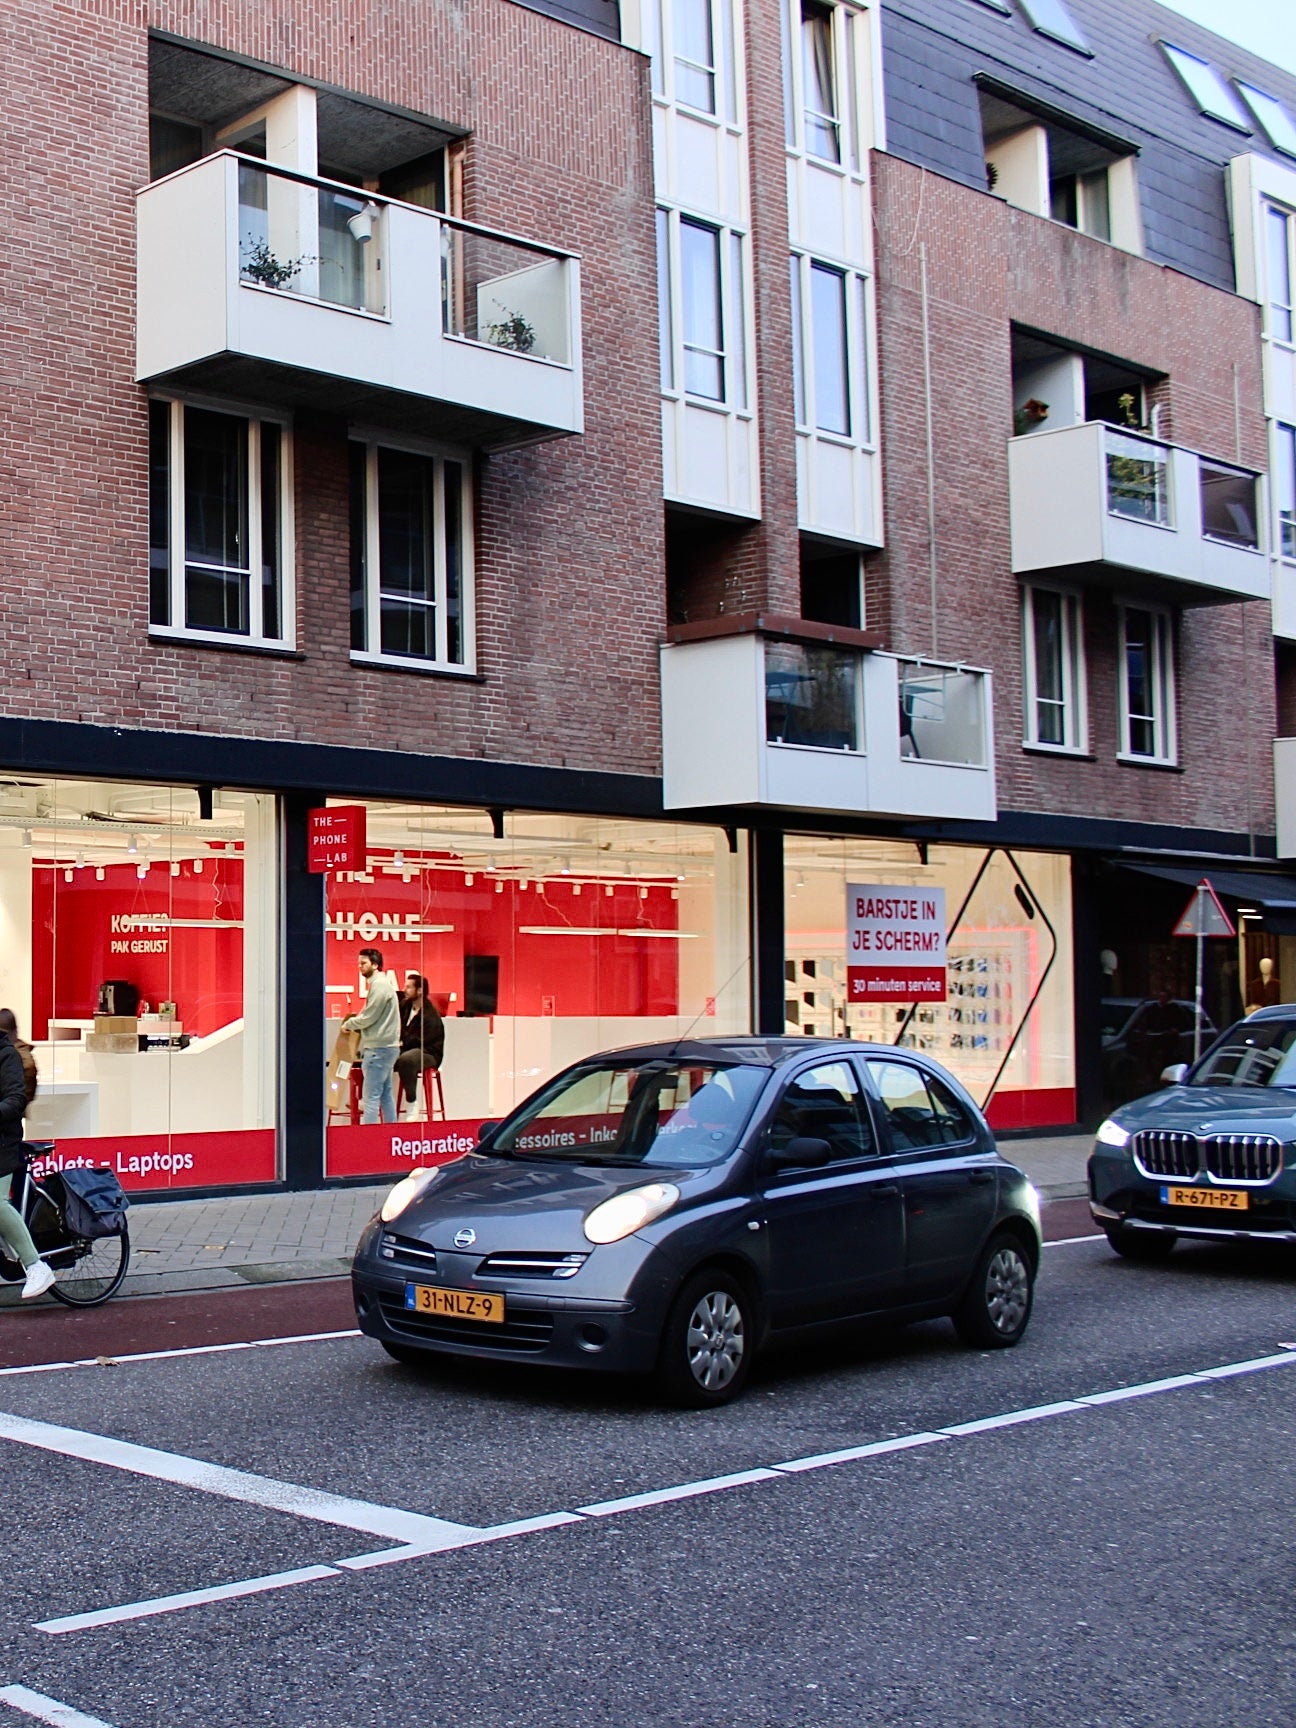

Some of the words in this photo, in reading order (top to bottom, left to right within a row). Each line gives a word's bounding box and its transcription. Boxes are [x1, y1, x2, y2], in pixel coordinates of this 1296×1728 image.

[313, 816, 333, 827] THE
[313, 833, 347, 846] PHONE
[326, 852, 348, 863] LAB
[856, 897, 918, 920] BARSTJE
[922, 900, 936, 920] IN
[110, 940, 130, 954] PAK
[130, 939, 169, 954] GERUST
[852, 929, 871, 951] JE
[875, 930, 940, 951] SCHERM?
[852, 978, 866, 994] 30
[867, 976, 906, 992] minuten
[908, 976, 942, 992] service
[391, 1133, 474, 1159] Reparaties
[116, 1151, 194, 1177] Laptops
[1174, 1189, 1239, 1207] R-671-PZ
[422, 1289, 493, 1317] 31-NLZ-9
